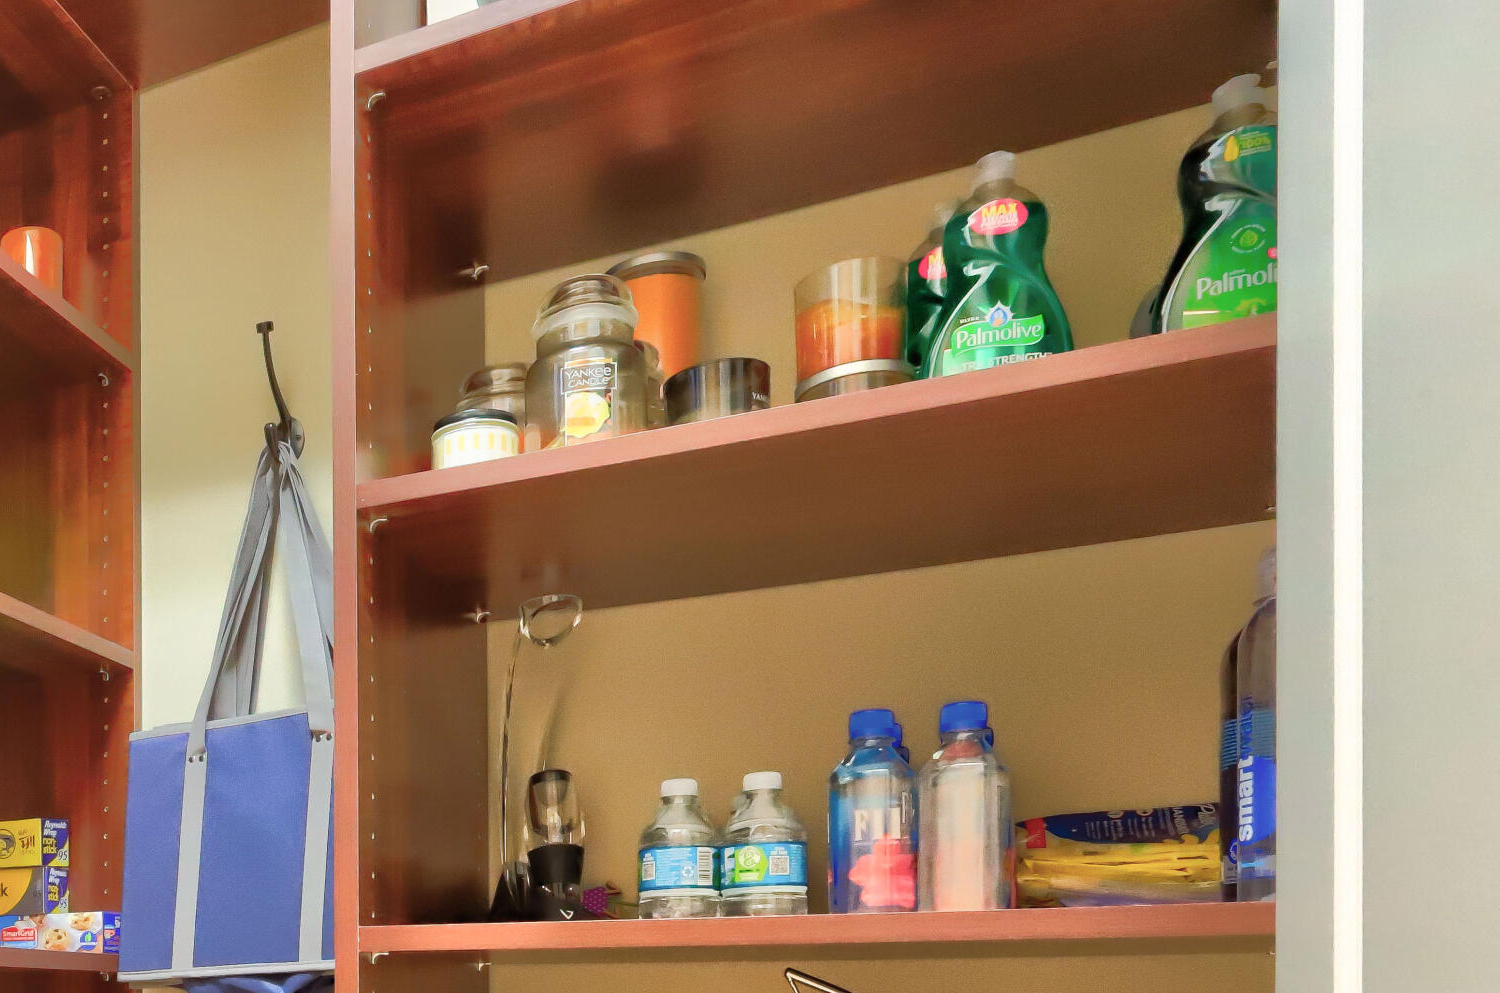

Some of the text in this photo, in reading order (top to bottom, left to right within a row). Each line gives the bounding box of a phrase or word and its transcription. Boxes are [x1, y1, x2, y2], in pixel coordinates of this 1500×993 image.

[981, 203, 1018, 218] MAX
[1196, 262, 1277, 300] Palmoli
[956, 322, 1043, 349] Palmolive
[1238, 756, 1254, 842] smart
[57, 849, 68, 860] 95
